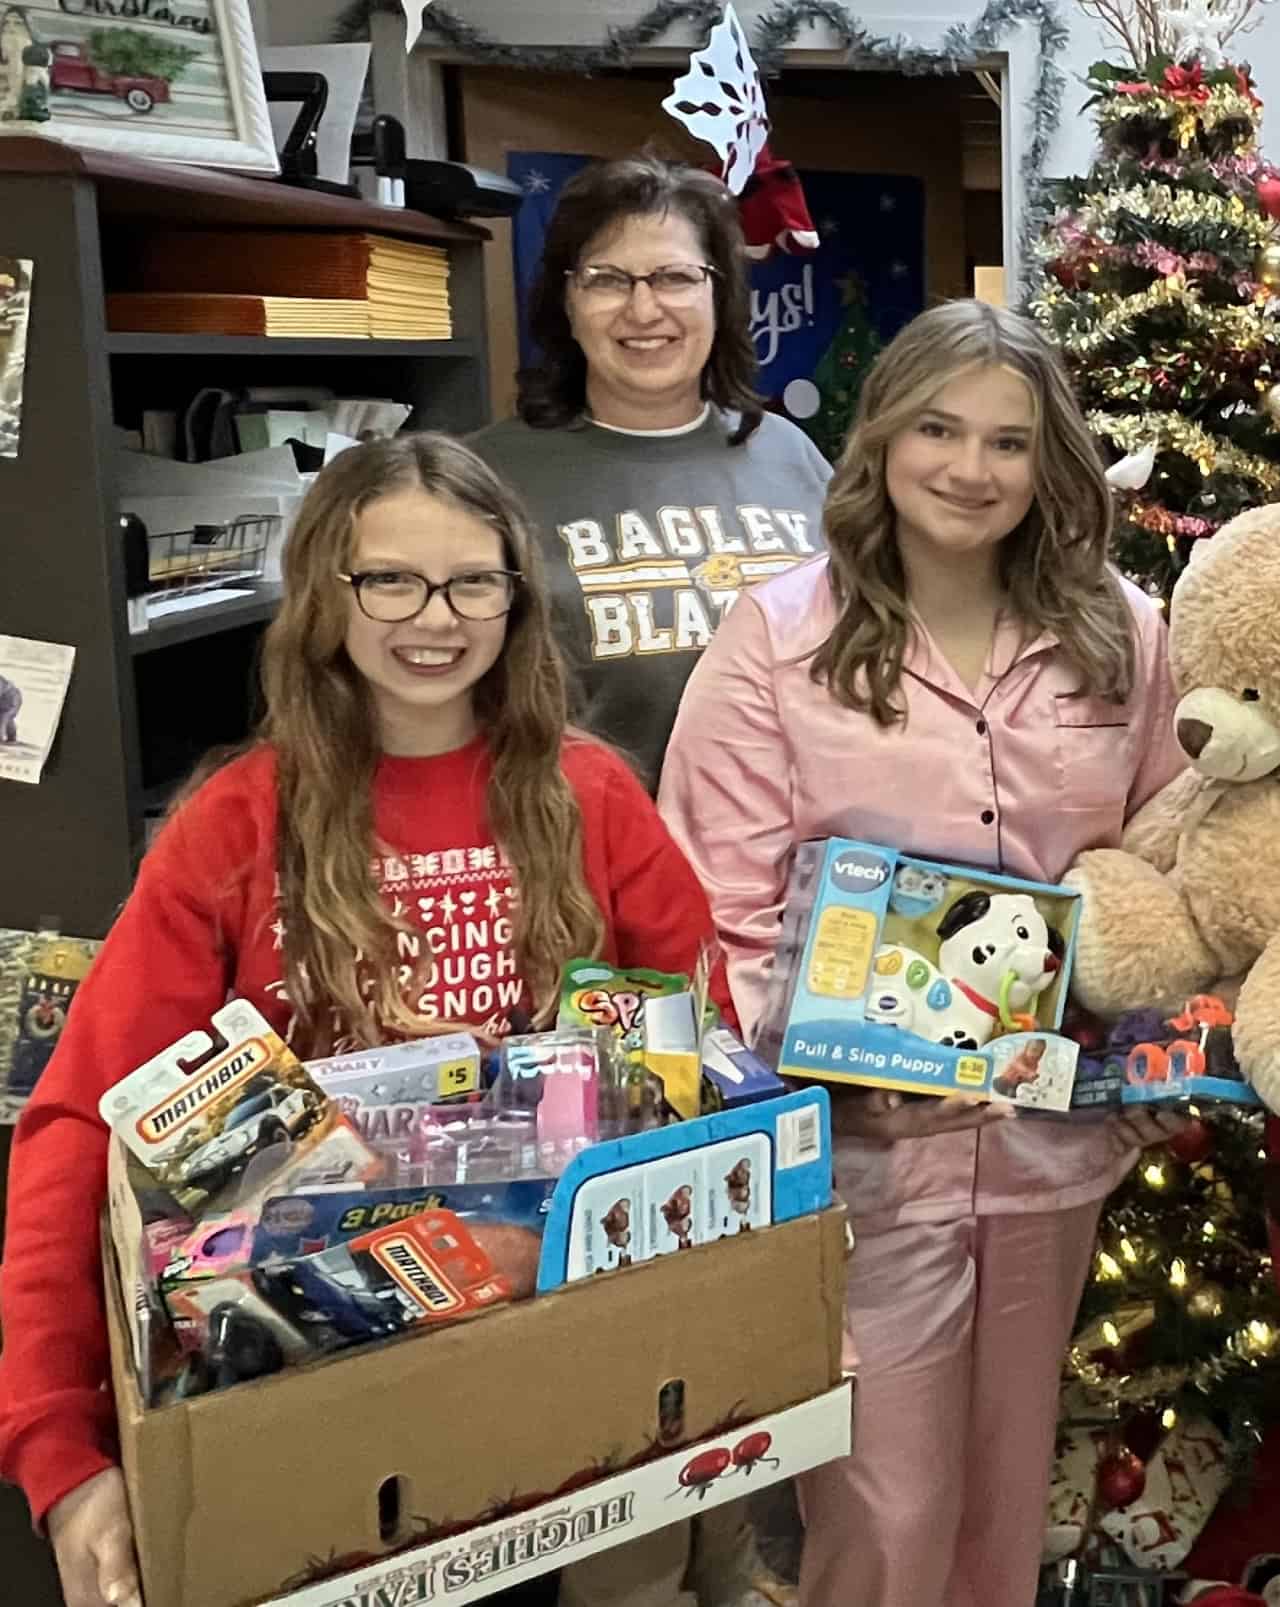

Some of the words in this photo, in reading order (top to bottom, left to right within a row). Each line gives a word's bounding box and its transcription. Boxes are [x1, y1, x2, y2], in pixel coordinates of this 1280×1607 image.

[556, 504, 815, 572] BAGLEY
[834, 860, 887, 882] vtech
[417, 979, 523, 1020] SNOW
[794, 1040, 827, 1058] Pull
[831, 1046, 844, 1060] &
[849, 1047, 886, 1068] Sing
[891, 1053, 944, 1075] Puppy
[151, 1047, 256, 1133] MATCHBOX
[385, 1243, 452, 1306] MATCHBOX
[443, 1491, 636, 1592] HUGHES
